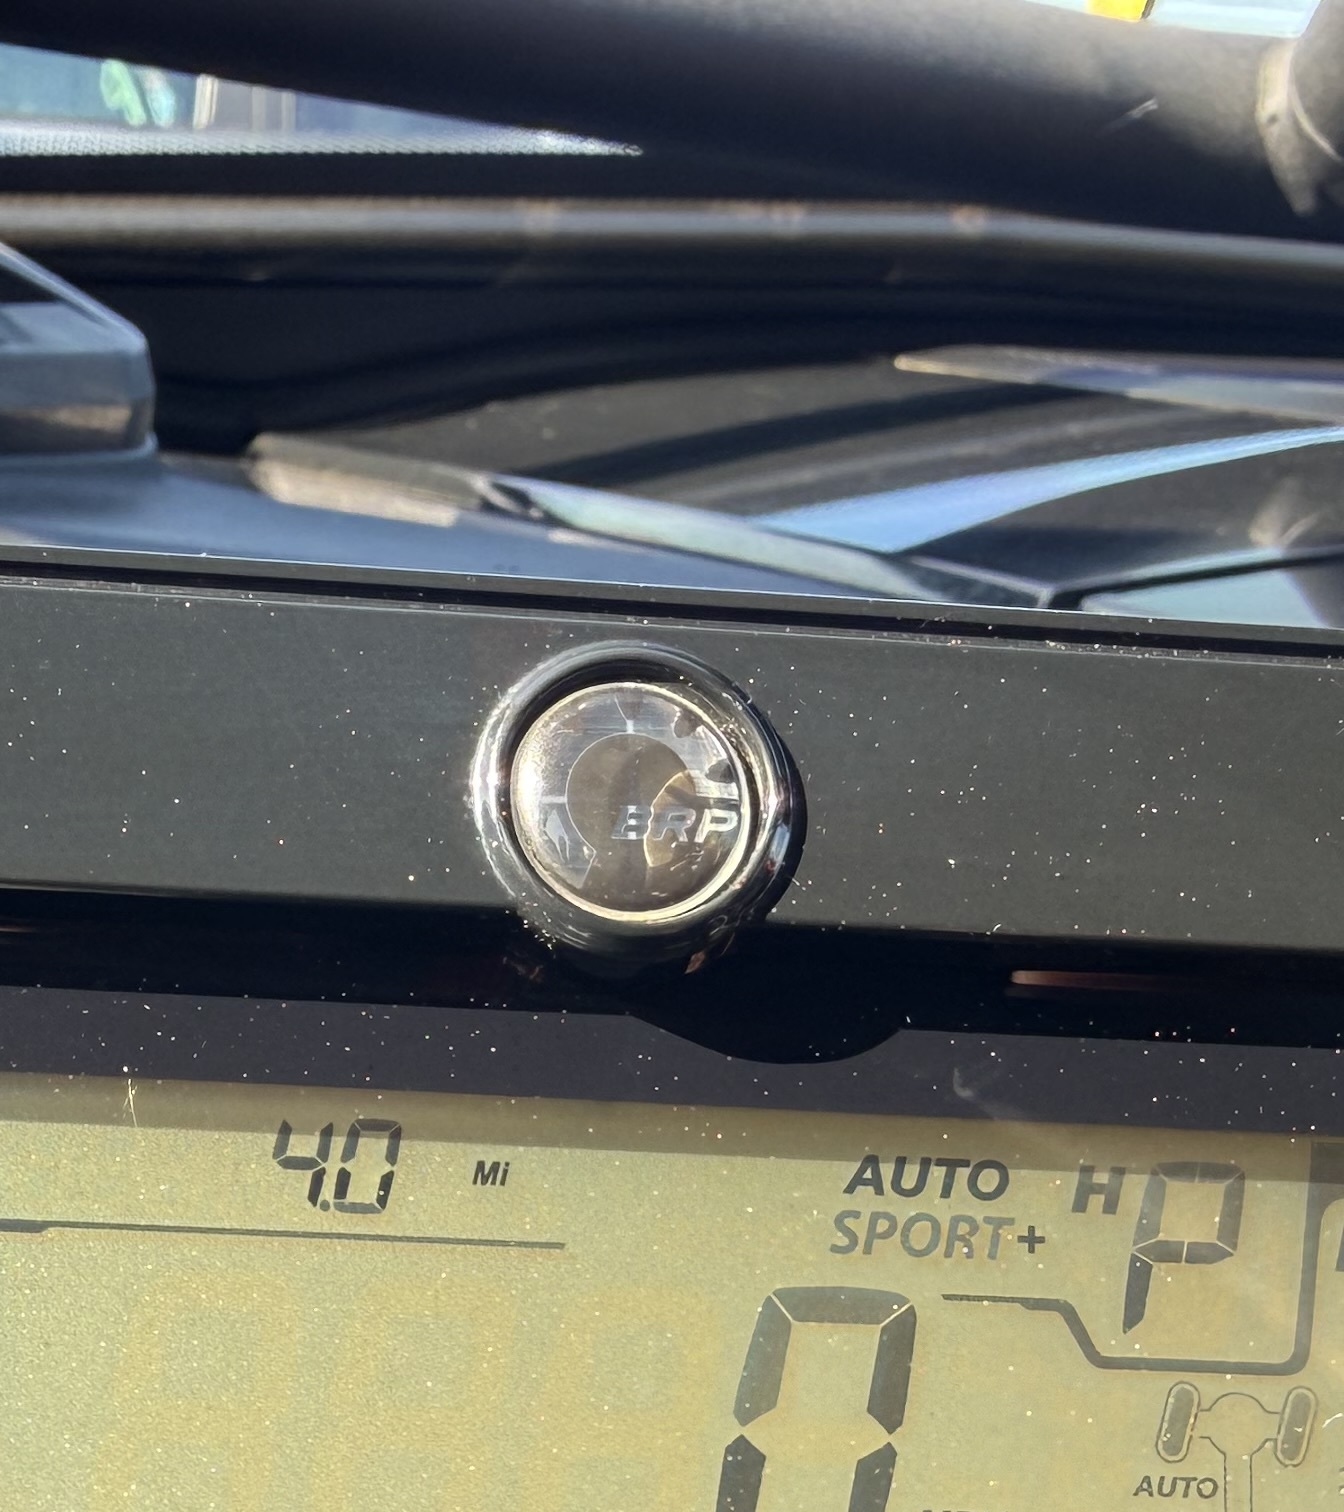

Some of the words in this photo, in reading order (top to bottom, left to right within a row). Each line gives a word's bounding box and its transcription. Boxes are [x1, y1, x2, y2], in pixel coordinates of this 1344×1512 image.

[610, 804, 739, 843] BRP
[472, 1160, 509, 1188] Mi
[843, 1154, 1010, 1200] AUTO
[829, 1209, 1047, 1261] SPORT+
[1071, 1164, 1127, 1215] H
[1123, 1161, 1247, 1336] P
[1132, 1475, 1220, 1501] AUTO
